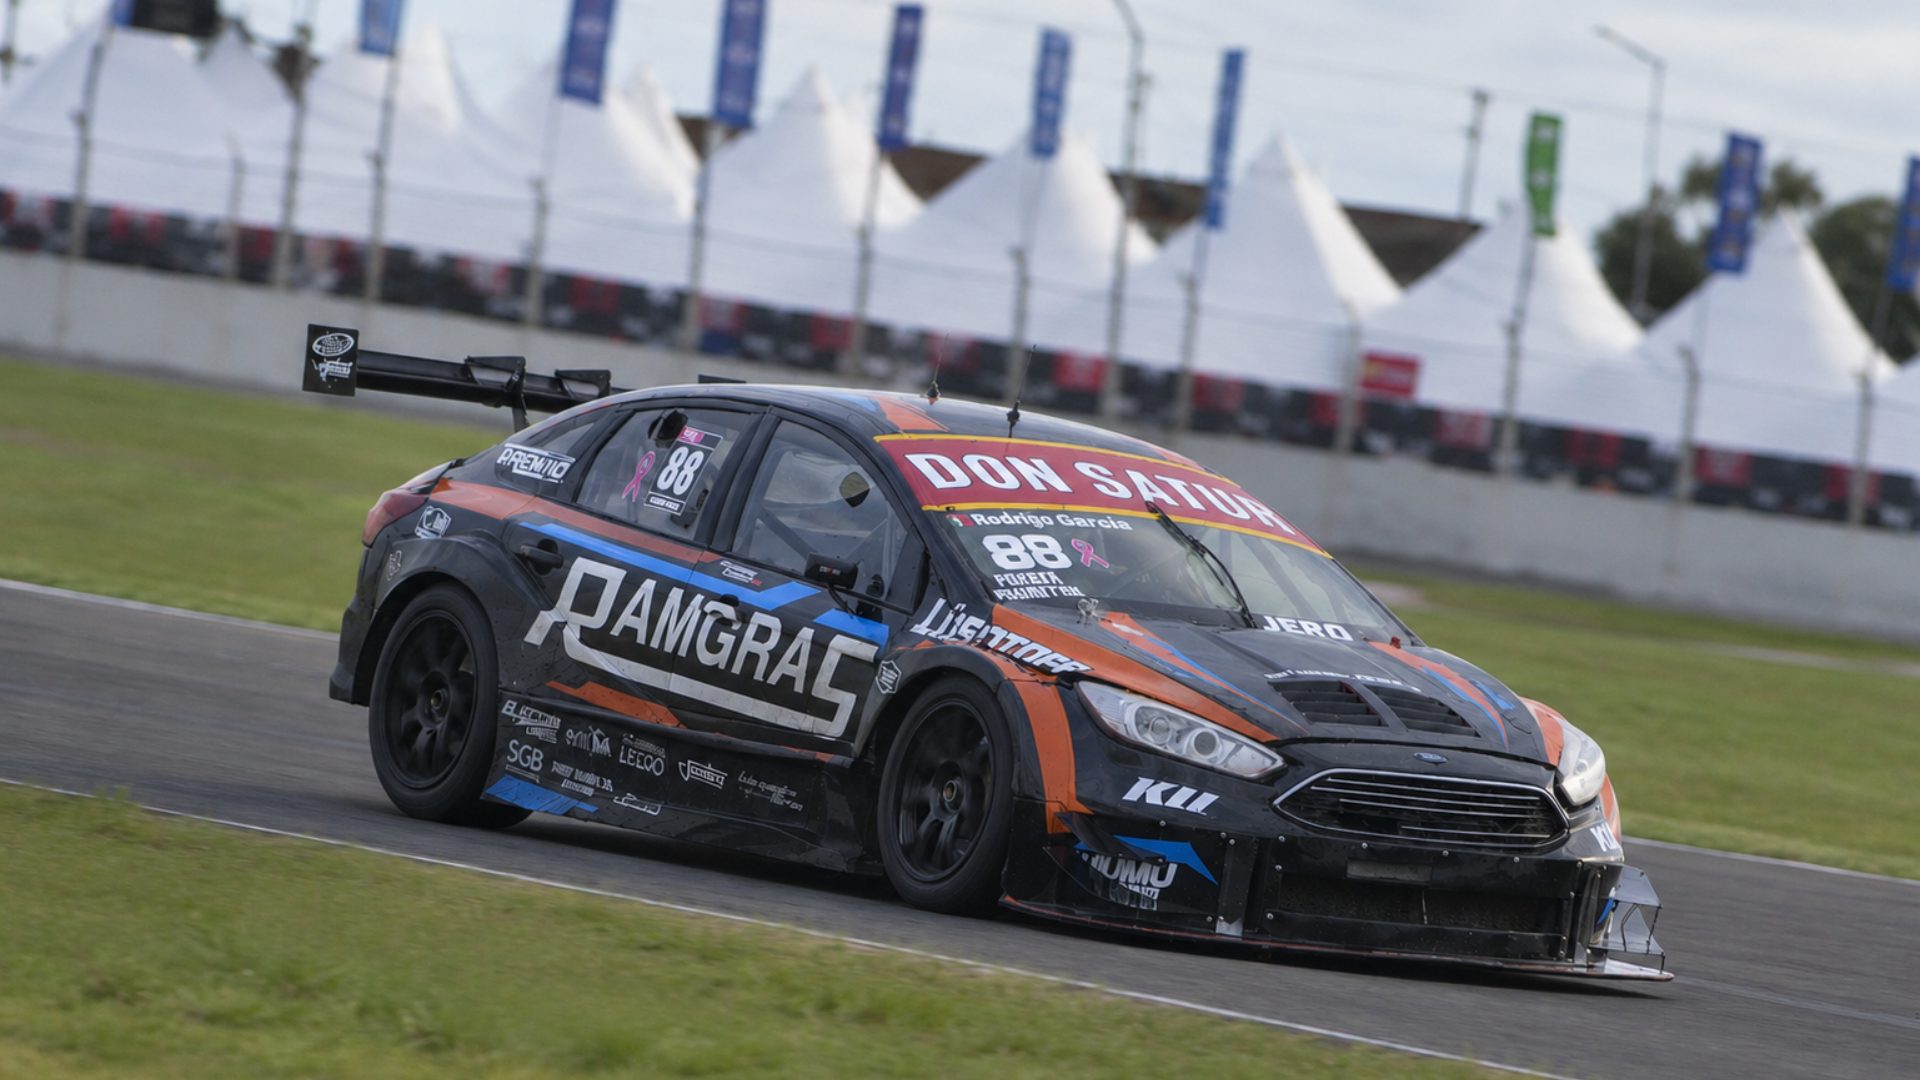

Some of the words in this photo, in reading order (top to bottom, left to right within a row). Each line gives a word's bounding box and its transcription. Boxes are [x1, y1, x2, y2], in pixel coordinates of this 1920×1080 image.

[657, 446, 704, 495] 88
[904, 452, 1073, 494] DON
[1073, 460, 1298, 536] SATUR
[971, 511, 1054, 530] Rodrigo
[982, 533, 1073, 570] 88
[1263, 616, 1354, 642] JERO
[507, 739, 544, 772] SGB
